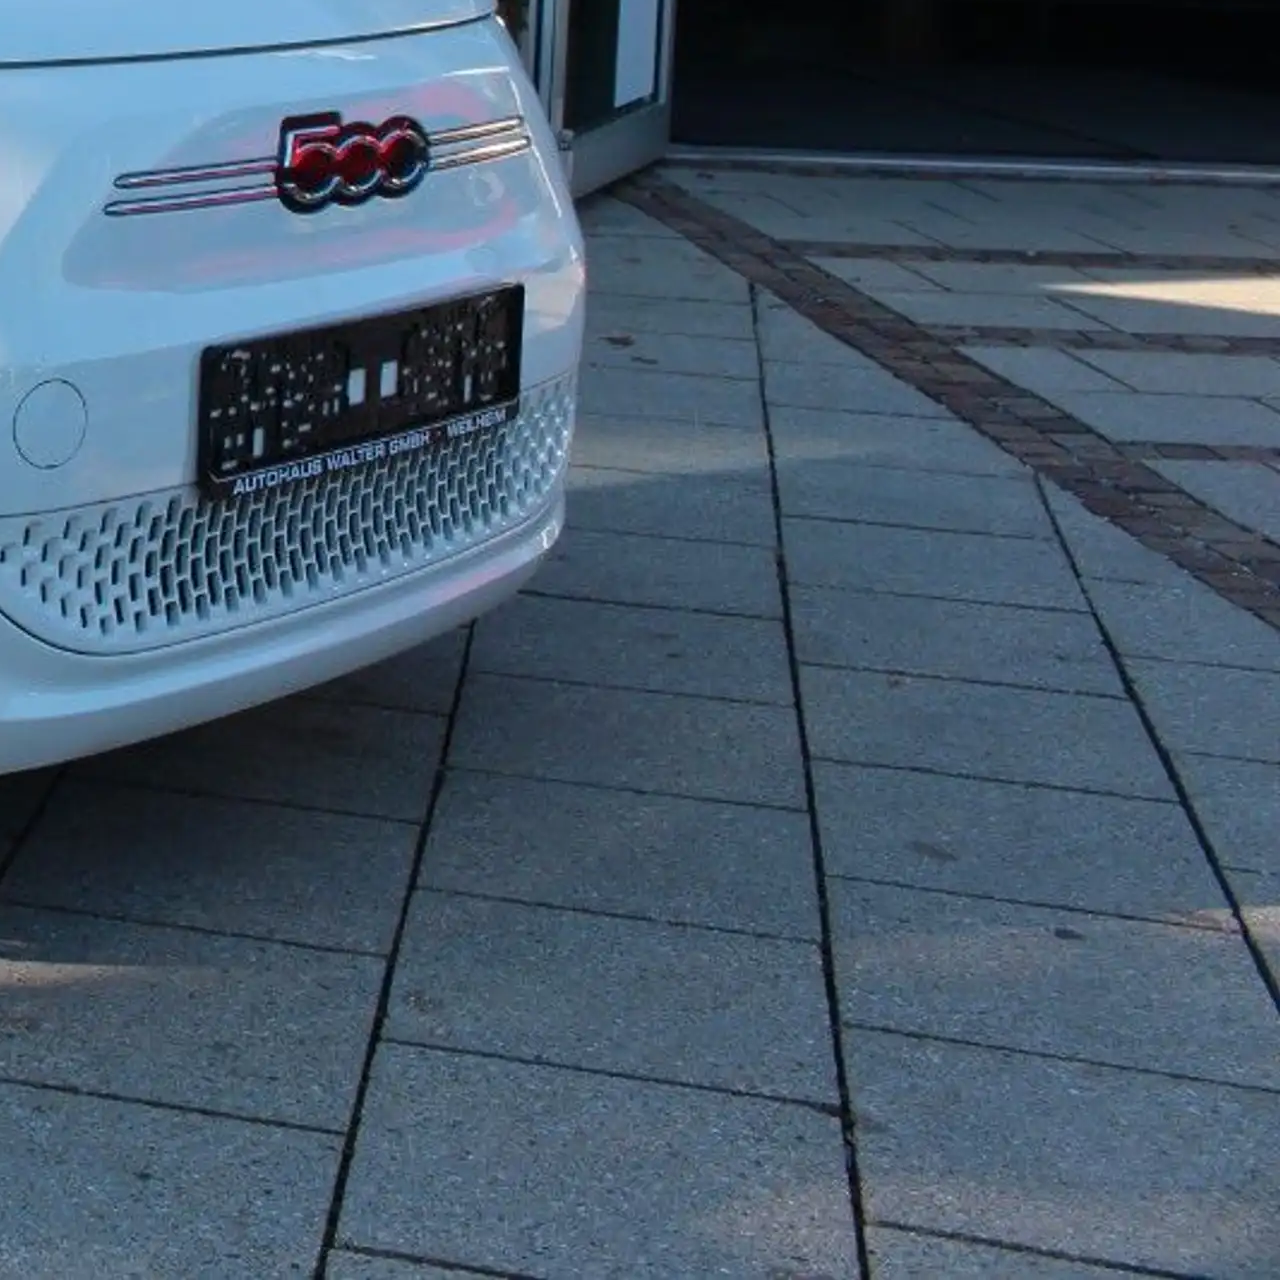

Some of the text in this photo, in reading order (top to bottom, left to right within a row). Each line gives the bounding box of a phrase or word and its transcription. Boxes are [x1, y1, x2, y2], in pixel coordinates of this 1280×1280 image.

[278, 111, 429, 213] 500
[233, 460, 321, 495] AUTOHAUS
[326, 442, 386, 470] WALTER
